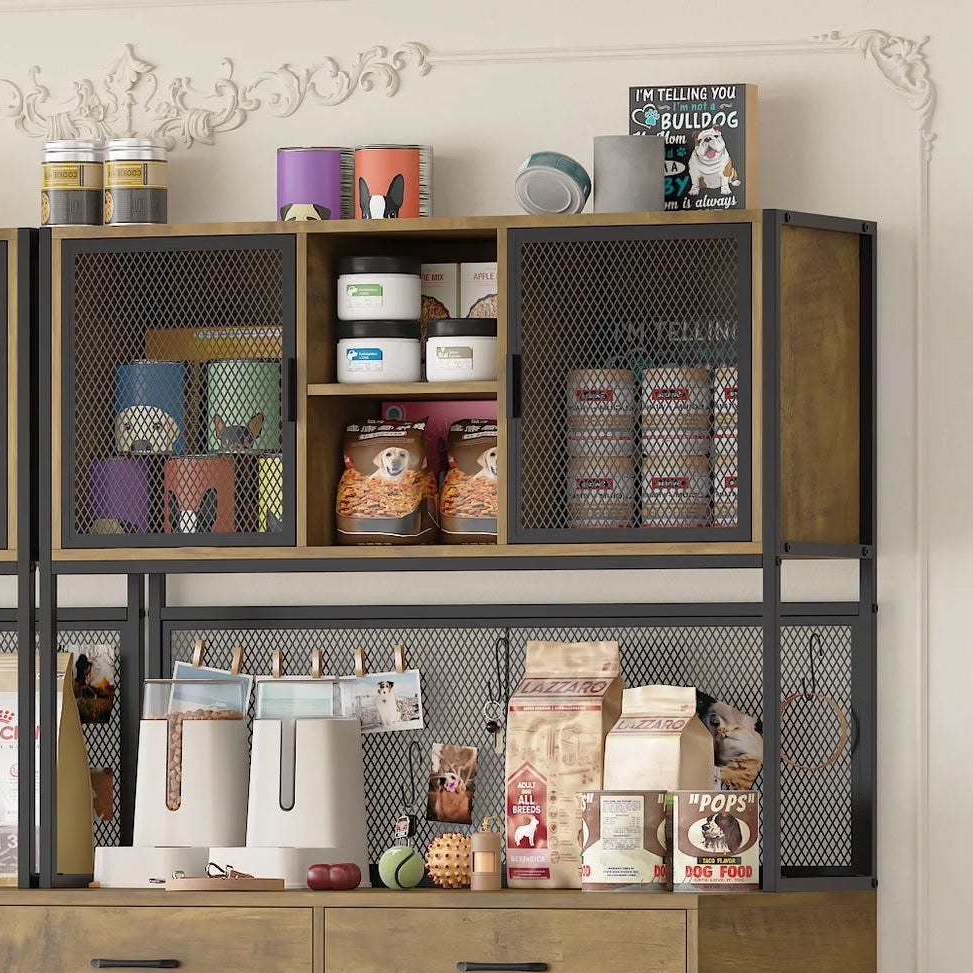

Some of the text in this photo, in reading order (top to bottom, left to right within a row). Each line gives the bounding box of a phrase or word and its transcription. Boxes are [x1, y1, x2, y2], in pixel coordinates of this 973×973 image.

[635, 86, 736, 102] I'M TELLING YOU
[672, 102, 688, 111] I'm
[691, 102, 707, 111] not
[661, 111, 739, 130] BULLDOG
[664, 175, 689, 197] BY
[695, 194, 738, 209] always
[431, 272, 444, 281] MIX
[473, 271, 495, 281] APPLE
[520, 681, 607, 694] LAZZARO
[615, 717, 686, 731] LAZZARO
[517, 781, 536, 789] ADULT
[517, 795, 535, 805] ALL
[512, 805, 541, 814] BREEDS
[685, 865, 753, 878] DOG FOOD
